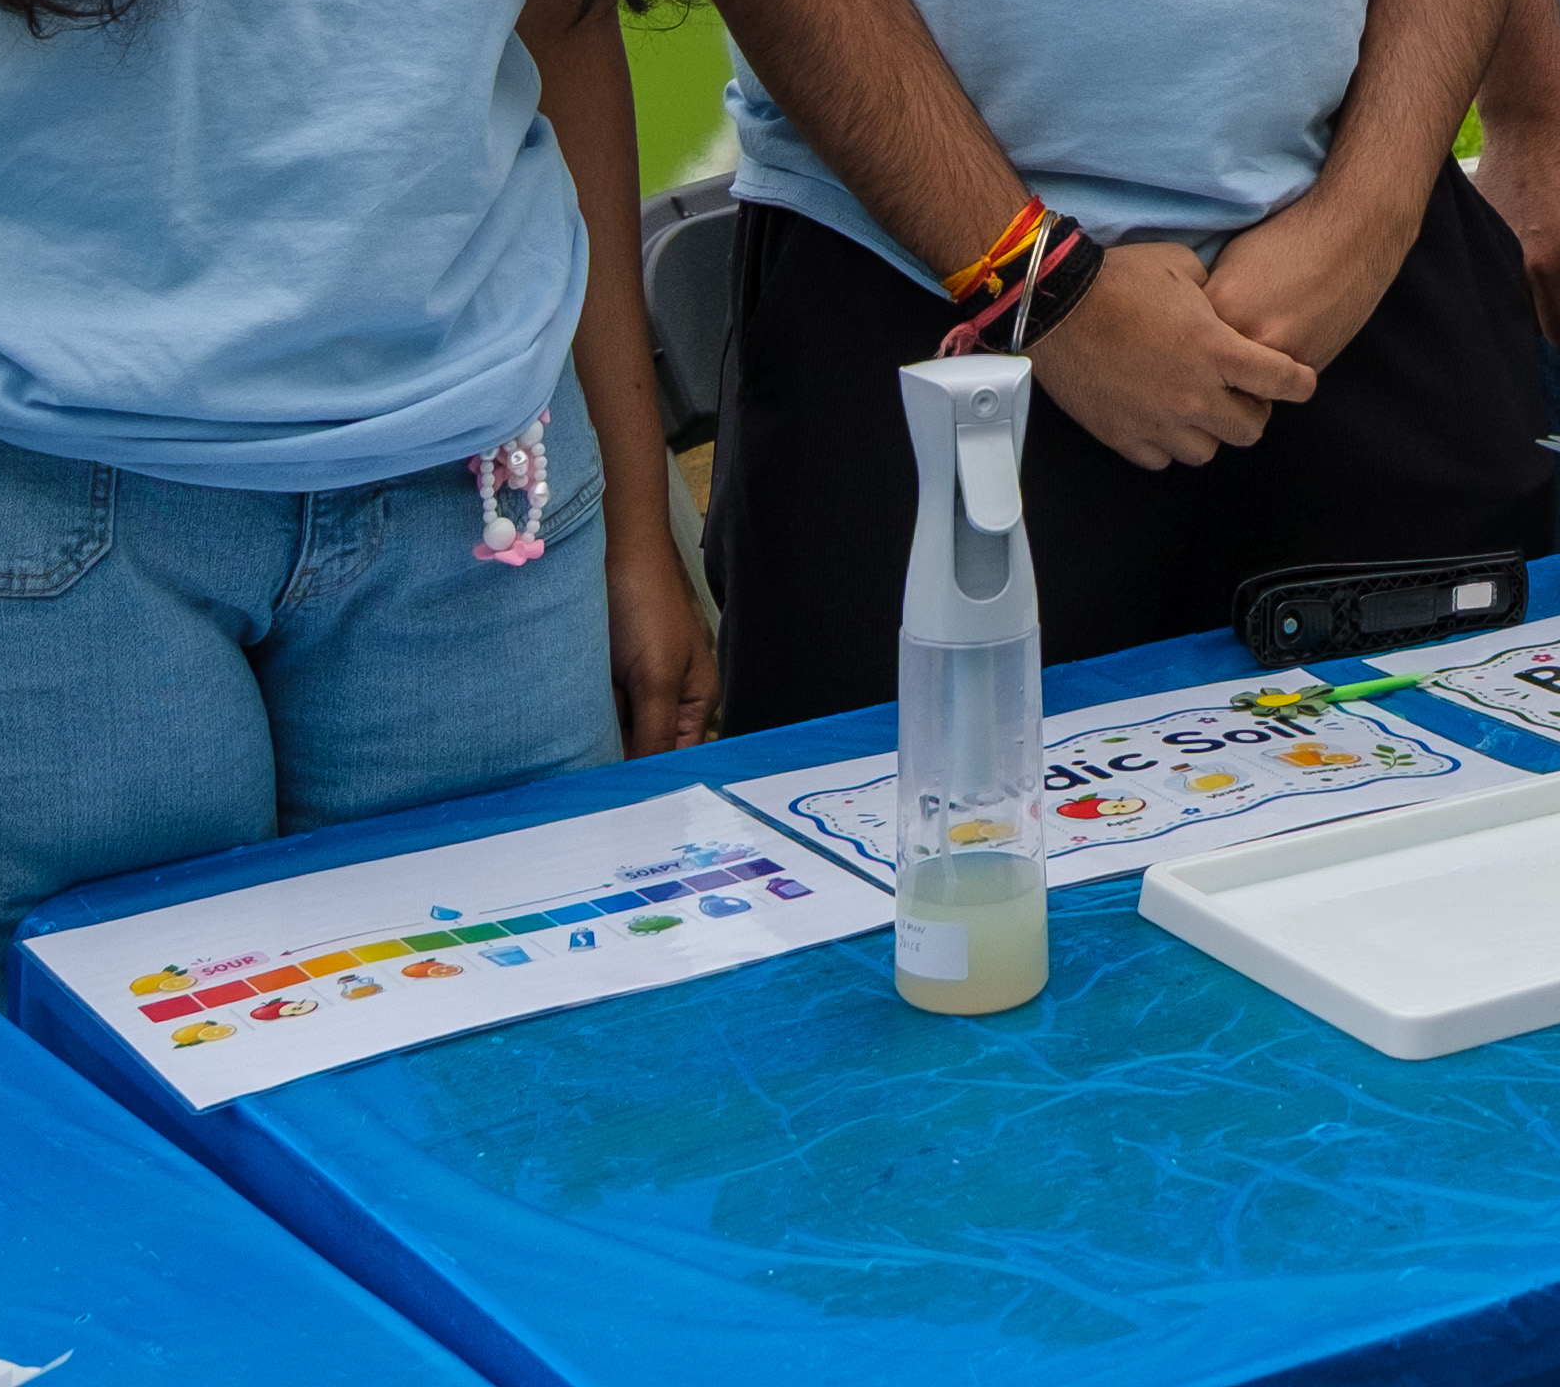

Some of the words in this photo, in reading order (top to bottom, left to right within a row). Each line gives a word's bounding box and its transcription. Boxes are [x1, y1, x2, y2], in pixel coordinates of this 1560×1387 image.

[1161, 717, 1317, 754] Soil
[625, 861, 682, 880] SOAPY
[201, 955, 258, 976] SOUR
